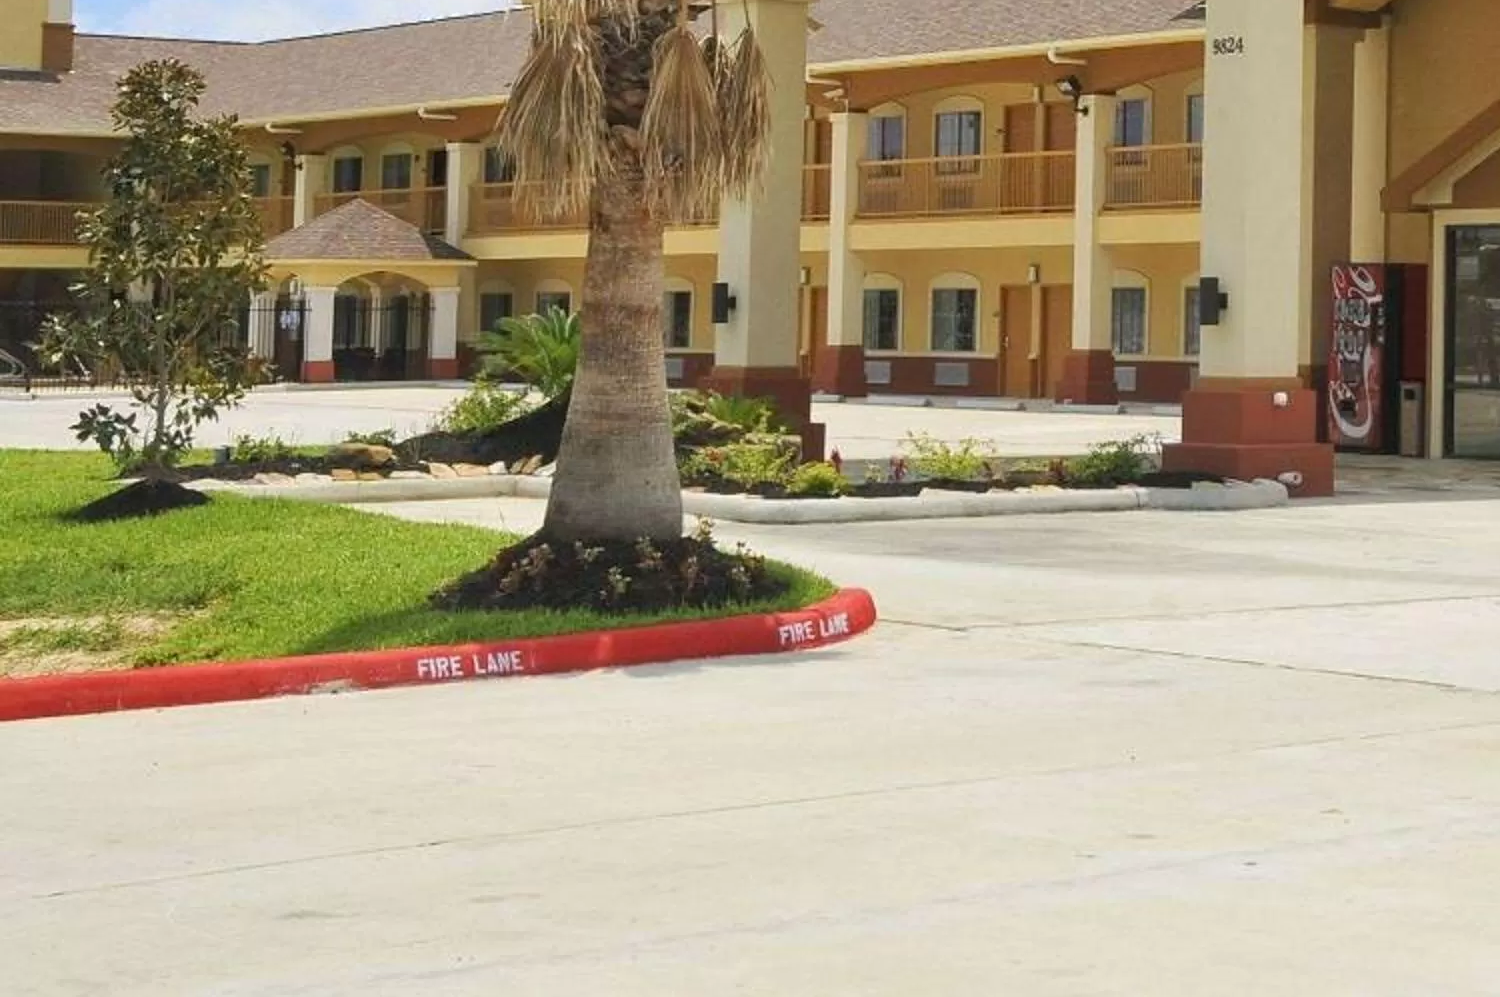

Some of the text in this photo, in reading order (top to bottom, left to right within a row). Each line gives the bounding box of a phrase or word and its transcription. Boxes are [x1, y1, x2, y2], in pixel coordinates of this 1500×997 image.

[778, 612, 850, 646] FIRE LANE
[417, 650, 524, 679] FIRE LANE
